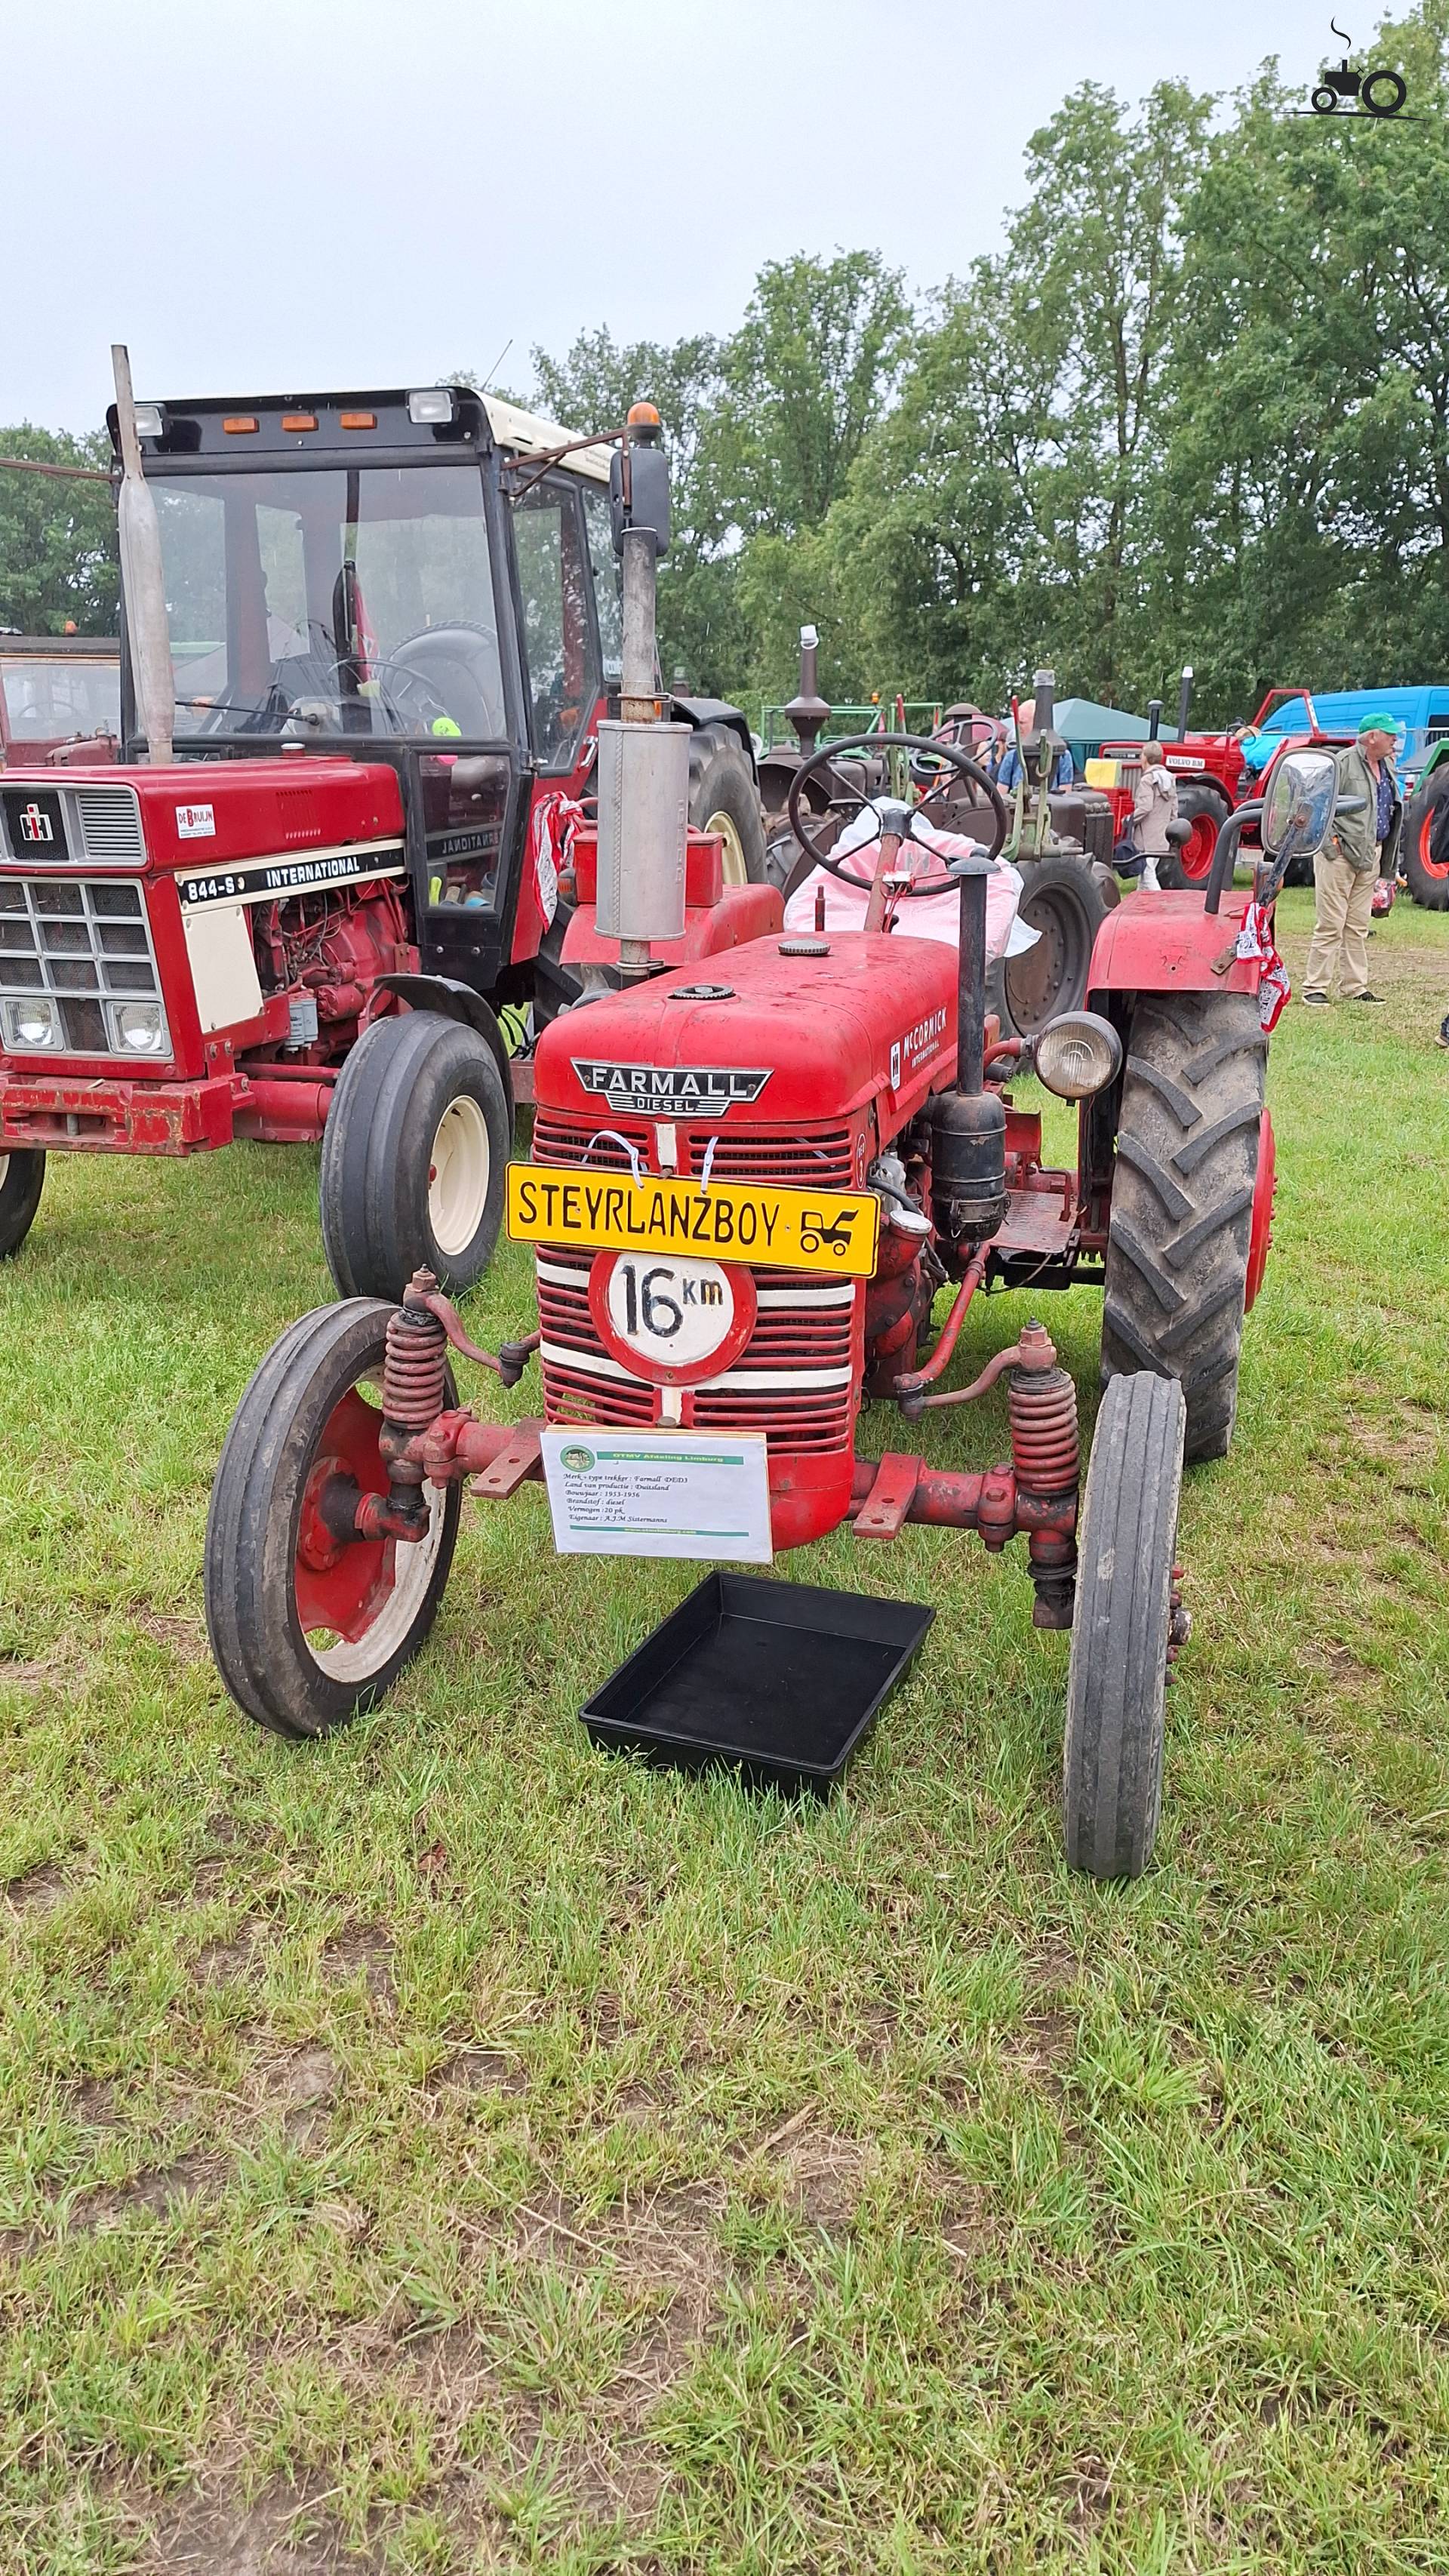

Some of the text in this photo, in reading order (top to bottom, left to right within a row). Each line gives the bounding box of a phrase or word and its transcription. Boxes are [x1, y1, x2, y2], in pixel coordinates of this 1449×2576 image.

[1168, 757, 1191, 766] VOLVO
[188, 856, 361, 900] 844-S INTERNATIONAL
[911, 1039, 940, 1069] INTERNATIONAL
[592, 1067, 747, 1097] FARMALL
[636, 1097, 695, 1112] DIESEL
[518, 1180, 780, 1247] STEYRLANZBOY
[620, 1264, 684, 1338] 16
[598, 1482, 629, 1490] productie
